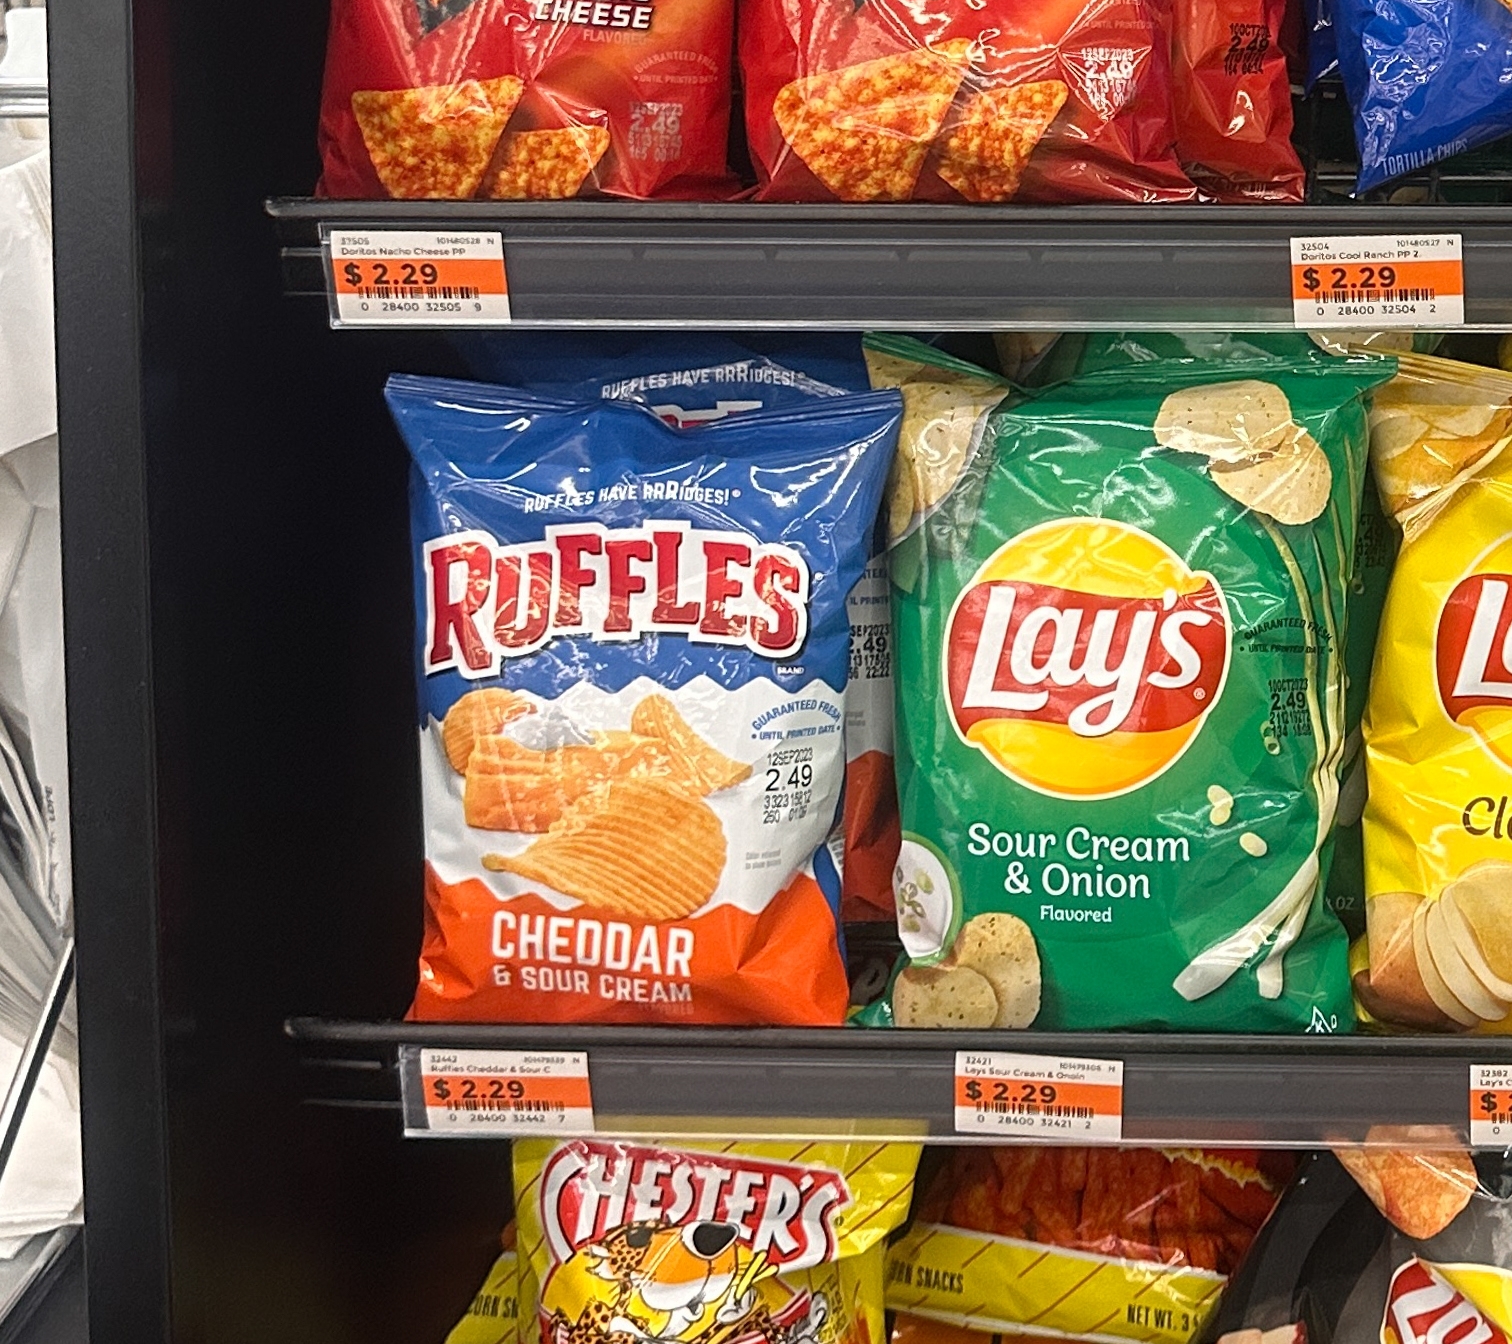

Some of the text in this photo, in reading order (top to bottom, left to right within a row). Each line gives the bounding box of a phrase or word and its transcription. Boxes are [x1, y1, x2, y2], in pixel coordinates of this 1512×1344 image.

[1381, 138, 1467, 176] TORTILLA CHIPS
[344, 263, 438, 286] $ 2.29
[1303, 266, 1395, 292] $ 2.29
[524, 491, 594, 514] RUFFLES
[600, 484, 638, 502] HAVE
[425, 525, 806, 674] RUFFLES
[963, 587, 1212, 738] Lay's
[752, 699, 816, 731] GUARANTEED
[1271, 692, 1306, 711] 2.49
[766, 765, 812, 792] 2.49
[968, 821, 1190, 862] Sour Cream
[1004, 861, 1151, 900] & Onion
[1039, 904, 1113, 925] Flavored
[491, 909, 693, 978] CHEDDAR
[494, 964, 693, 1003] & SOUR CREAM
[433, 1079, 524, 1100] $ 2.29
[965, 1080, 1056, 1103] $ 2.29
[1481, 1092, 1497, 1112] $
[544, 1146, 841, 1264] CHESTER'S
[917, 1266, 964, 1293] SNACKS
[1127, 1303, 1149, 1325] NET
